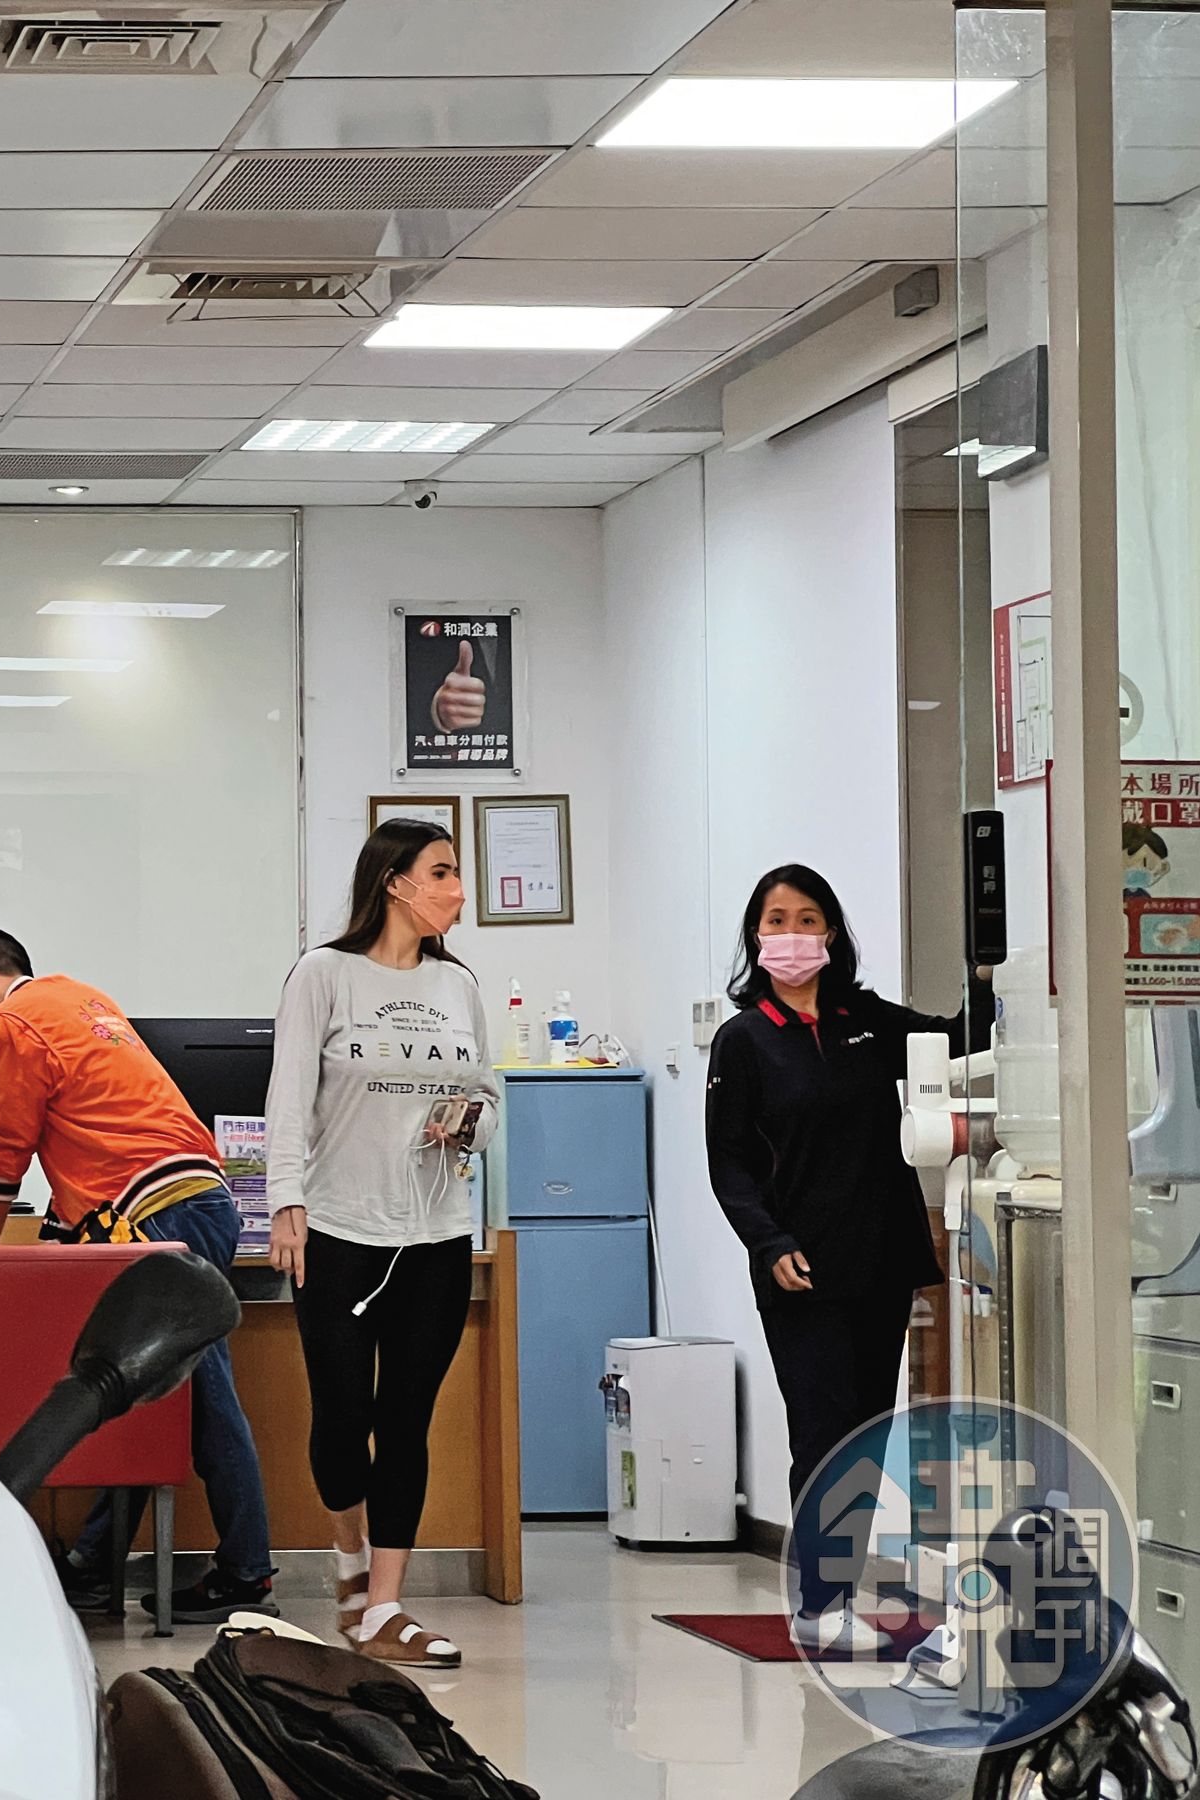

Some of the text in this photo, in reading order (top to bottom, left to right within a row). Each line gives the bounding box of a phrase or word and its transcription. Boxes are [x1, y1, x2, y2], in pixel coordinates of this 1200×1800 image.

[443, 622, 498, 637] 和潤企業
[1121, 772, 1200, 795] 本場所
[375, 1001, 425, 1020] ATHLETIC
[367, 1082, 415, 1093] UNITED
